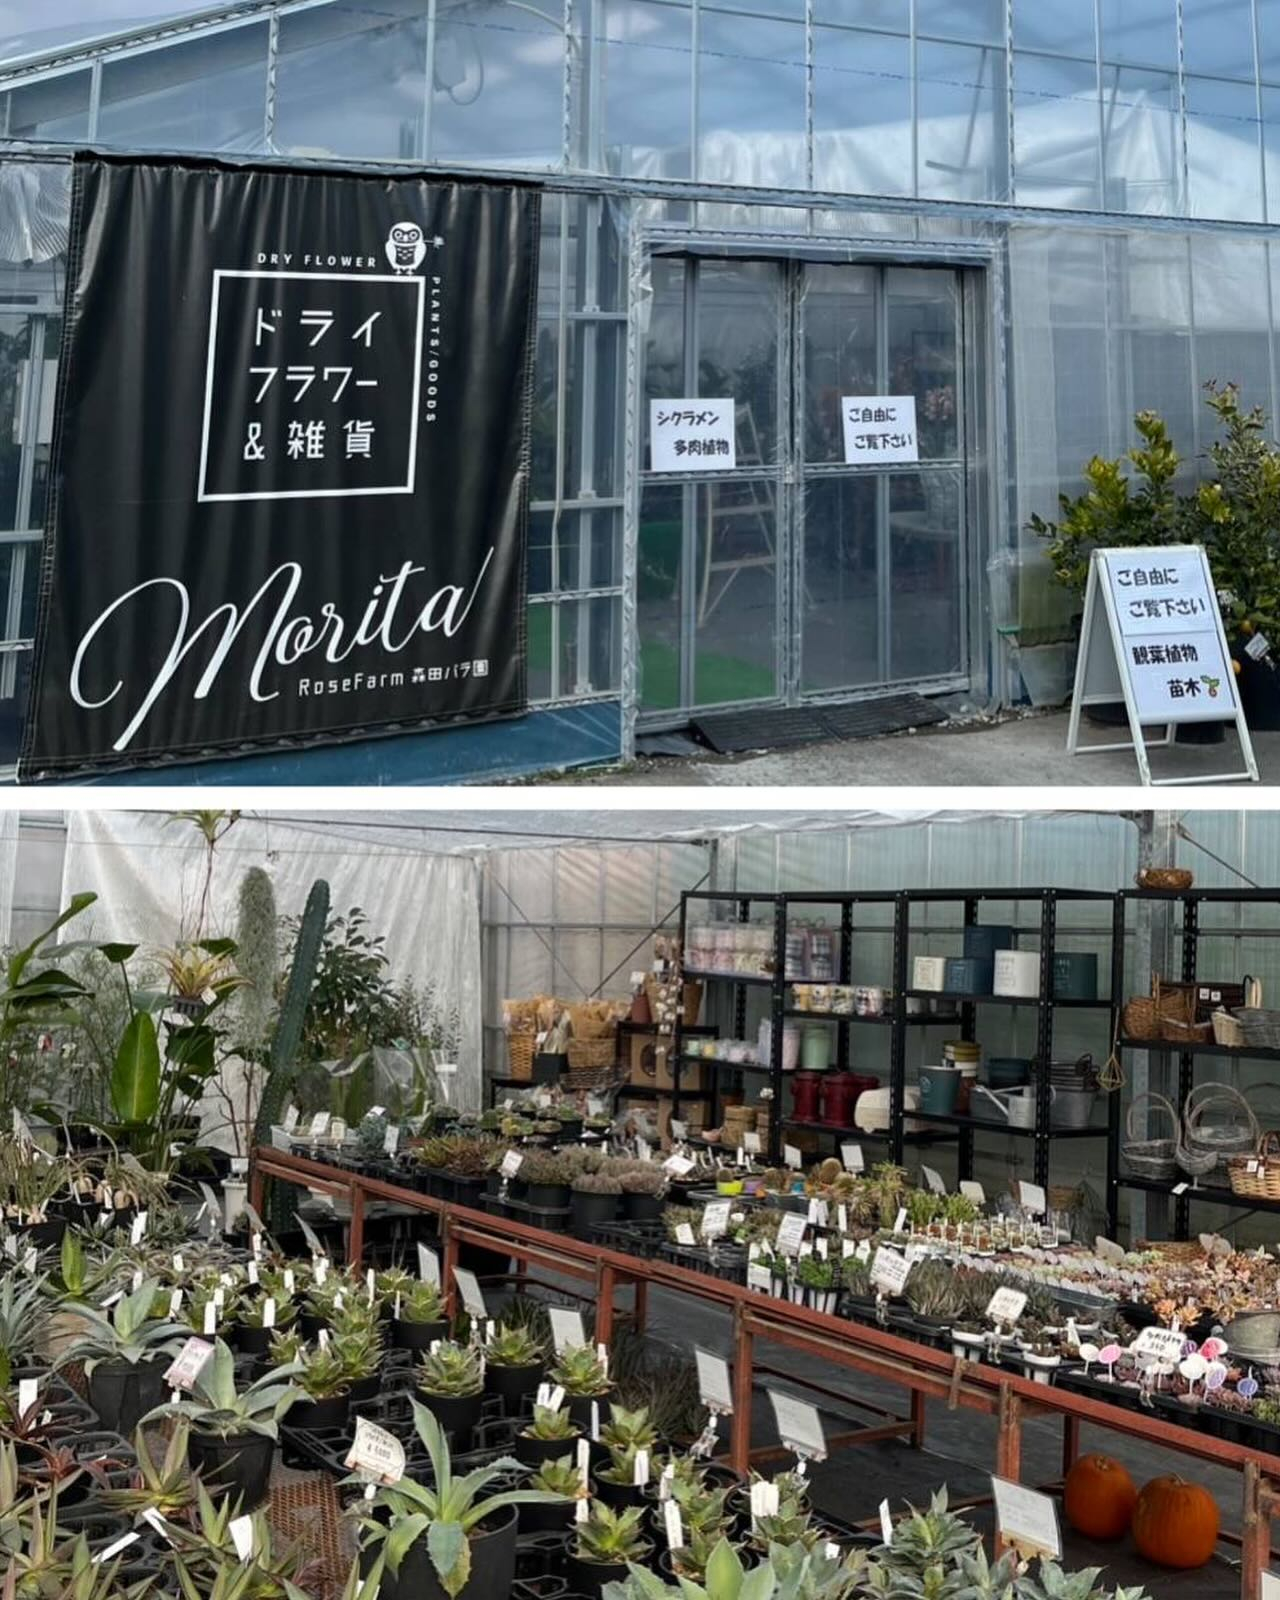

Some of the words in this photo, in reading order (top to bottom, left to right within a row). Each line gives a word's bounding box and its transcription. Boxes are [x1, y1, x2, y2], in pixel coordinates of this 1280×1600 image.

[256, 252, 292, 265] DRY
[304, 254, 376, 268] FLOWER
[255, 307, 382, 348] ドライ
[426, 276, 441, 422] PLANTS/GOODS
[249, 365, 378, 403] フラワー
[657, 410, 720, 426] シクラメン
[849, 406, 897, 424] ご自由に
[674, 439, 730, 457] 多肉植物
[854, 433, 913, 450] ご覧下さい
[1117, 568, 1180, 587] ご自由に
[1129, 598, 1206, 618] ご覧下さい
[70, 546, 494, 752] Morita
[1131, 643, 1199, 666] 観葉植物
[299, 671, 404, 697] RoseFarm
[1167, 677, 1201, 699] 苗木
